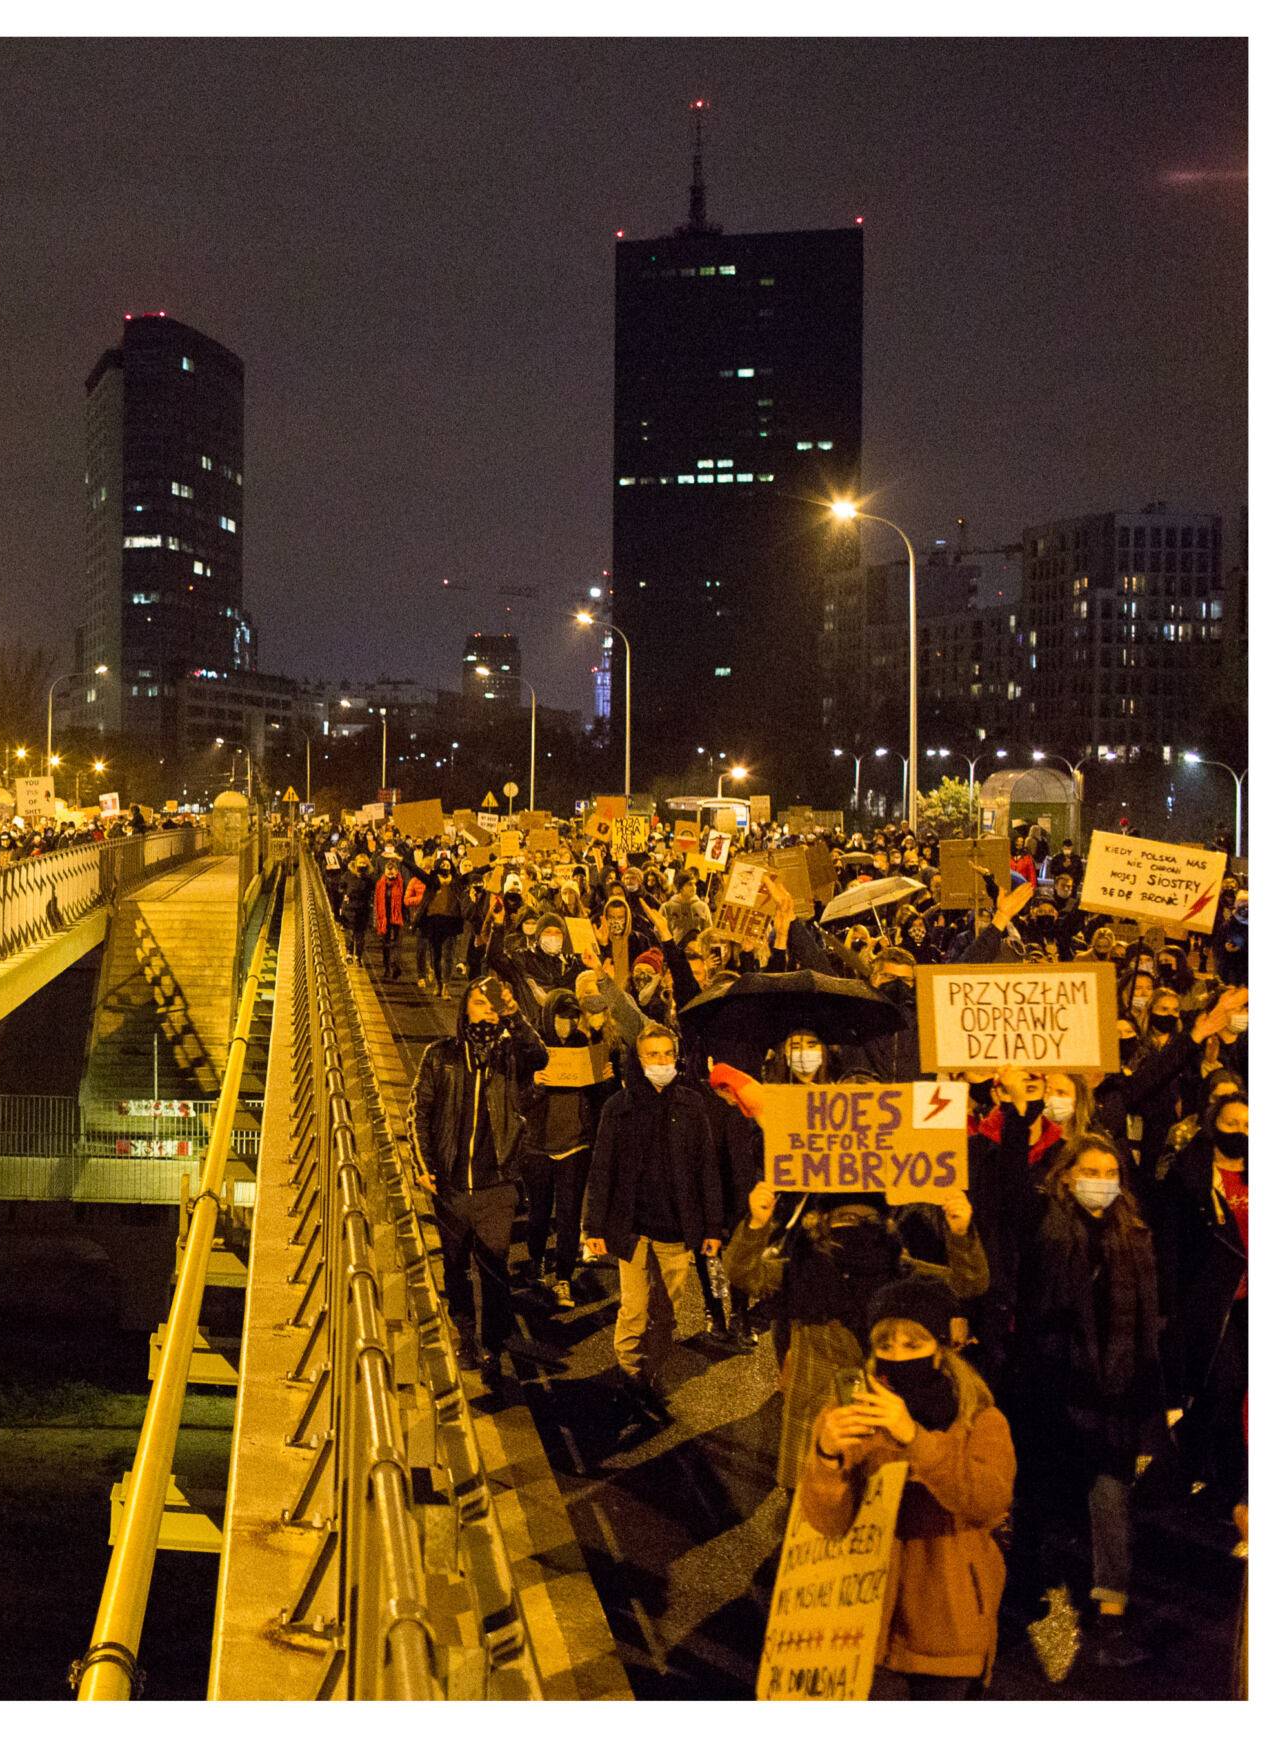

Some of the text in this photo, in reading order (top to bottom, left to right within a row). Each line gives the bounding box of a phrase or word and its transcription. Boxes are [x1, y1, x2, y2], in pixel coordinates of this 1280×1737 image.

[1140, 850, 1178, 864] POLSKA
[948, 981, 1089, 1006] PRZYSZŁAM
[960, 1004, 1069, 1033] ODPRAWIĆ
[967, 1033, 1065, 1060] DZIADY
[806, 1090, 903, 1131] HOES
[788, 1130, 894, 1153] BEFORE
[773, 1151, 957, 1190] EMBRYOS
